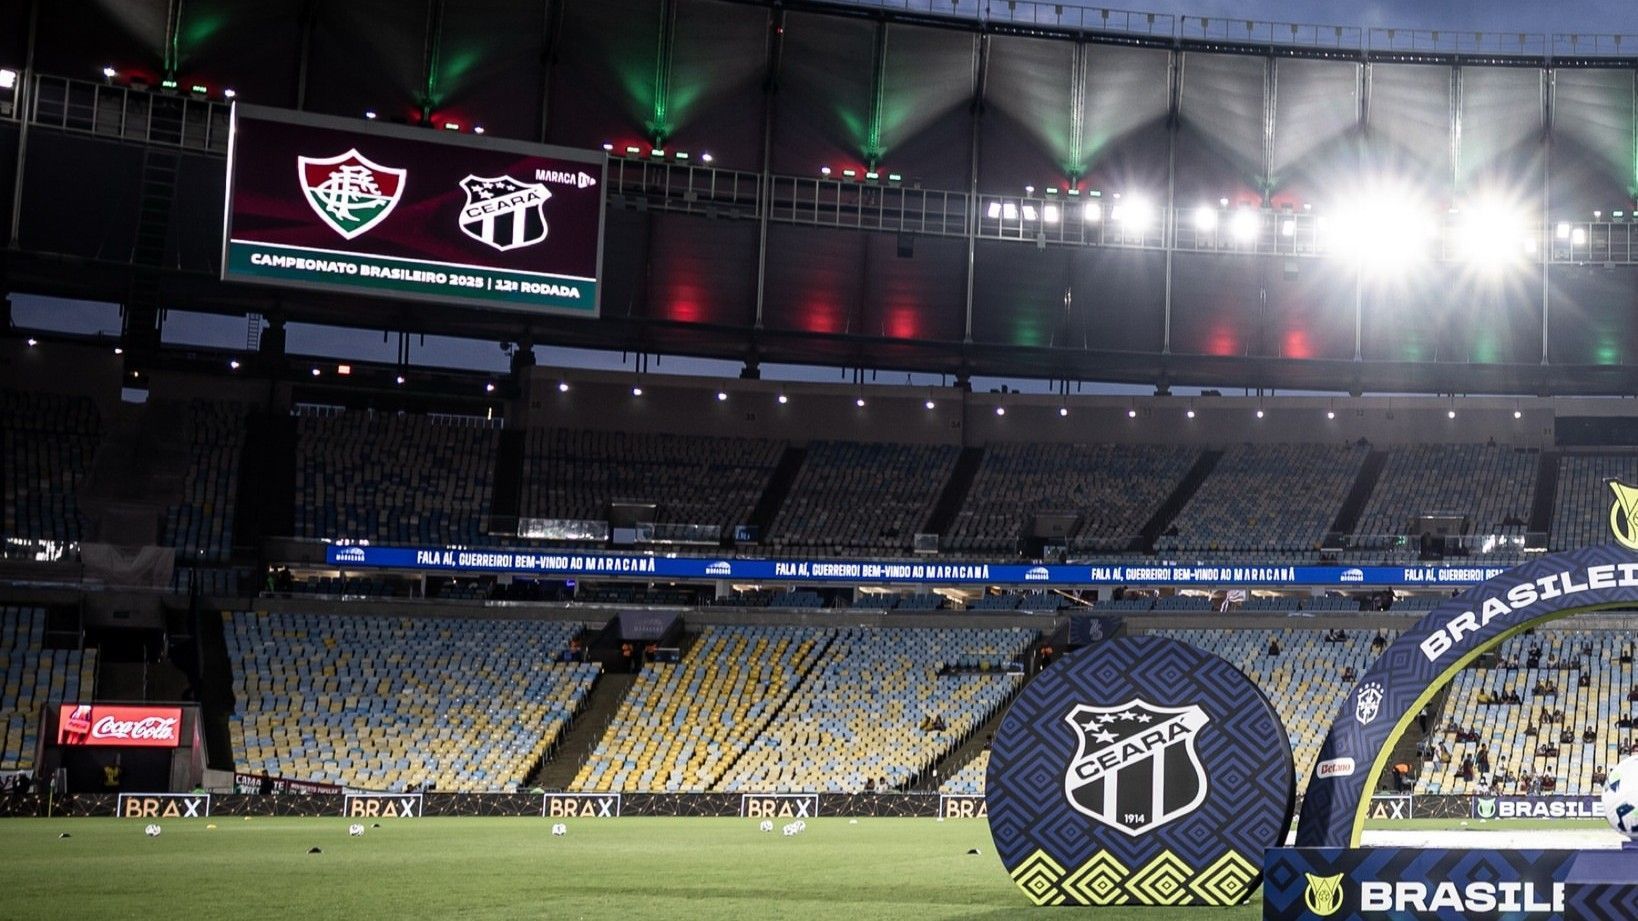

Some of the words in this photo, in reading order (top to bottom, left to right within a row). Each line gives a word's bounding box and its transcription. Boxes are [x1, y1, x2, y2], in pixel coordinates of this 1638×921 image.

[466, 189, 541, 218] CEARÁ
[251, 253, 357, 275] CAMPEONATO
[360, 264, 447, 284] BRASILEIRO
[449, 274, 484, 288] 2025
[521, 281, 580, 298] RODADA
[417, 551, 440, 565] FALA
[443, 551, 456, 567] AÍ,
[459, 552, 512, 568] GUERREIRO!
[515, 554, 568, 569] BEM-VINDO
[570, 556, 583, 569] AO
[585, 557, 656, 572] MARACANÃ
[775, 562, 796, 576] FALA
[798, 562, 809, 577] AÍ,
[812, 563, 860, 577] GUERREIRO!
[862, 564, 911, 578] BEM-VINDO
[912, 565, 924, 578] AO
[926, 564, 989, 579] MARACANÃ
[1091, 567, 1111, 580] FALA
[1113, 566, 1124, 582] AÍ,
[1126, 567, 1171, 580] GUERREIRO!
[1173, 567, 1219, 581] BEM-VINDO
[1220, 567, 1231, 580] AO
[1234, 566, 1295, 581] MARACANÃ
[1404, 568, 1424, 581] FALA
[1425, 566, 1436, 582] AÍ,
[1438, 568, 1484, 581] GUERREIRO!
[92, 716, 176, 740] Coca-Cola
[1075, 716, 1192, 780] CEARÁ
[1320, 762, 1351, 775] Betano
[126, 799, 201, 817] BRAX
[351, 799, 416, 817] BRAX
[550, 799, 613, 817] BRAX
[749, 799, 811, 818] BRAX
[1364, 801, 1405, 819] AX
[1123, 813, 1145, 824] 1914
